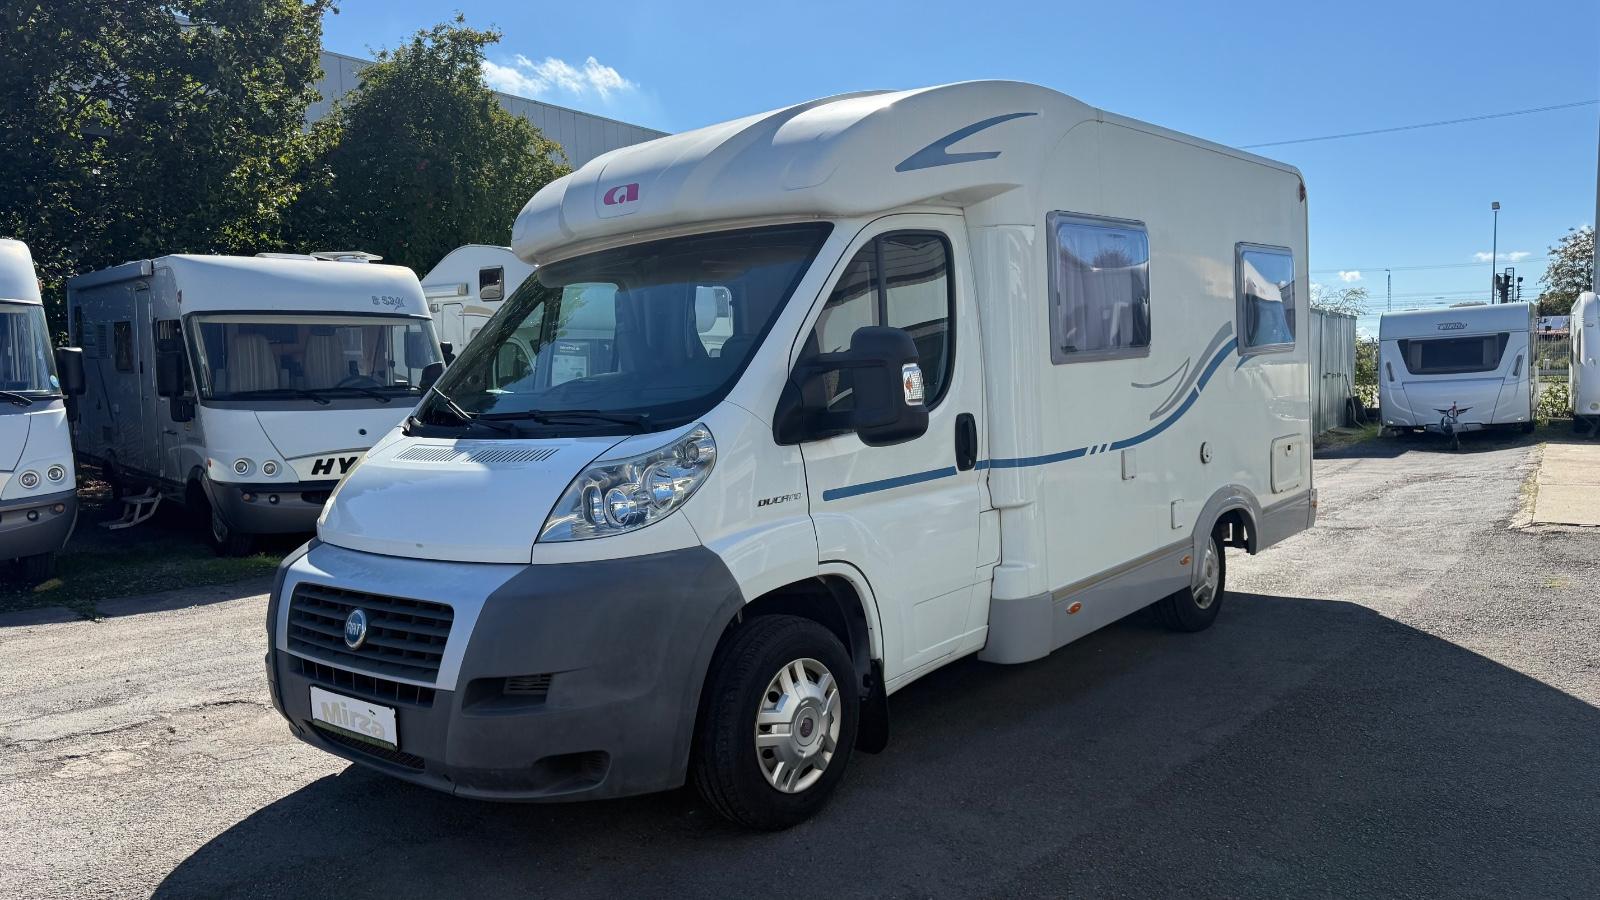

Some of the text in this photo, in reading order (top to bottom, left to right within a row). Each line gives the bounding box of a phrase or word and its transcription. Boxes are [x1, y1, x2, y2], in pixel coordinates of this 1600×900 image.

[311, 456, 358, 475] HY
[757, 492, 802, 507] DUCATO
[320, 701, 386, 739] Mirza
